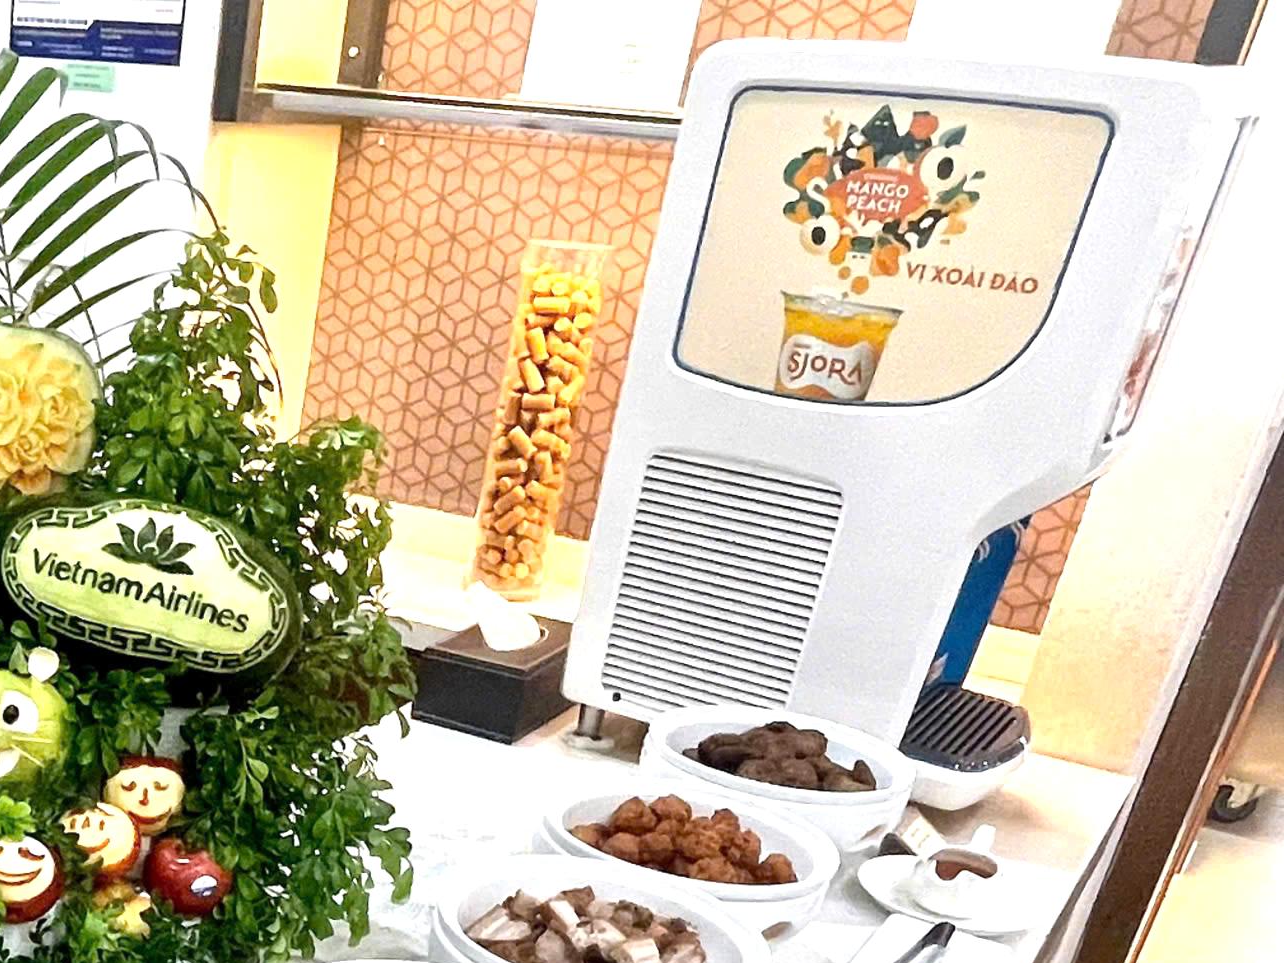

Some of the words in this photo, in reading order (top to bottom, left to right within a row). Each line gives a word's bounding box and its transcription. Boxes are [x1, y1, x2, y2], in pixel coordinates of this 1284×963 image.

[846, 181, 909, 198] MANGO
[846, 194, 902, 213] PEACH
[787, 351, 862, 385] SJORA
